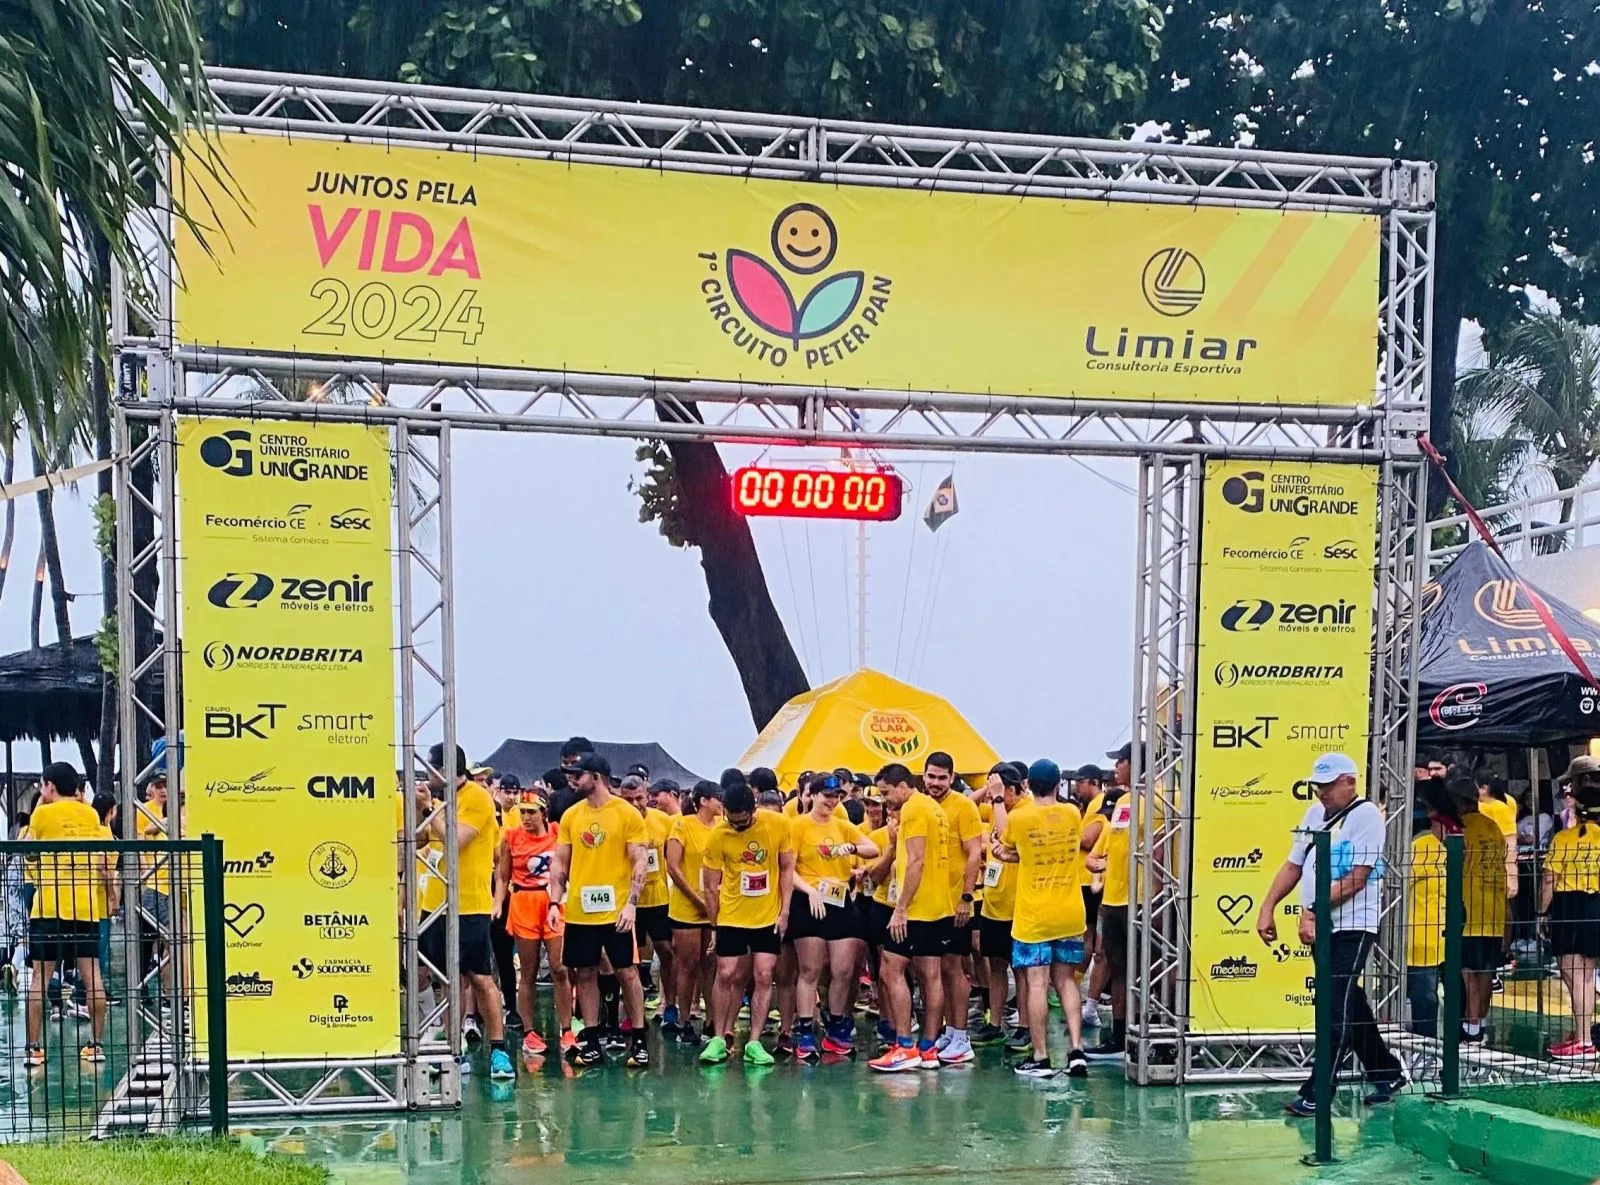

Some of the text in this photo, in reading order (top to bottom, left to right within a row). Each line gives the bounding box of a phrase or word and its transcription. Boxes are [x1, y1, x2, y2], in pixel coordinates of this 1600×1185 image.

[306, 171, 477, 206] JUNTOS PELA
[307, 204, 481, 279] VIDA
[302, 277, 485, 345] 2024
[701, 278, 788, 367] CIRCUITO
[805, 324, 870, 370] PETER
[862, 275, 892, 326] PAN
[1085, 326, 1257, 361] Limiar
[1086, 359, 1242, 376] Consultoria Esportiva
[259, 434, 308, 446] CENTRO
[259, 445, 350, 459] UNIVERSITÁRIO
[1271, 474, 1310, 484] CENTRO
[740, 471, 886, 512] 00 00 00
[1270, 483, 1345, 496] UNIVERSITÁRIO
[206, 514, 306, 530] Fecomércio CE
[330, 514, 372, 530] Sesc
[252, 534, 289, 544] Sistema
[1223, 547, 1304, 560] Fecomércio CE
[1323, 546, 1358, 559] Sesc
[280, 574, 374, 602] zenir
[280, 601, 319, 611] móveis
[334, 602, 374, 612] eletros
[1279, 598, 1356, 624] zenir
[1278, 624, 1310, 633] móveis
[1322, 625, 1355, 633] eletros
[1458, 633, 1600, 655] Limia
[236, 646, 363, 662] NORDBRITA
[1470, 650, 1547, 661] Consultoria
[1240, 665, 1343, 679] NORDBRITA
[205, 704, 287, 739] BKT
[298, 712, 373, 731] smart
[872, 715, 908, 724] SANTA
[870, 724, 916, 732] CLARA
[1213, 717, 1279, 748] BKT
[1287, 724, 1349, 740] smart
[328, 735, 369, 744] eletron
[1311, 743, 1345, 752] eletron
[307, 775, 375, 799] CMM
[223, 860, 254, 873] mn
[1213, 856, 1246, 869] emn
[590, 893, 610, 903] 449
[304, 911, 369, 926] BETÂNIA
[319, 927, 355, 939] KIDS
[226, 941, 263, 949] LadyDriver
[1212, 964, 1256, 975] medeiros
[226, 981, 272, 992] edeiros
[309, 1014, 374, 1025] DigitalFotos
